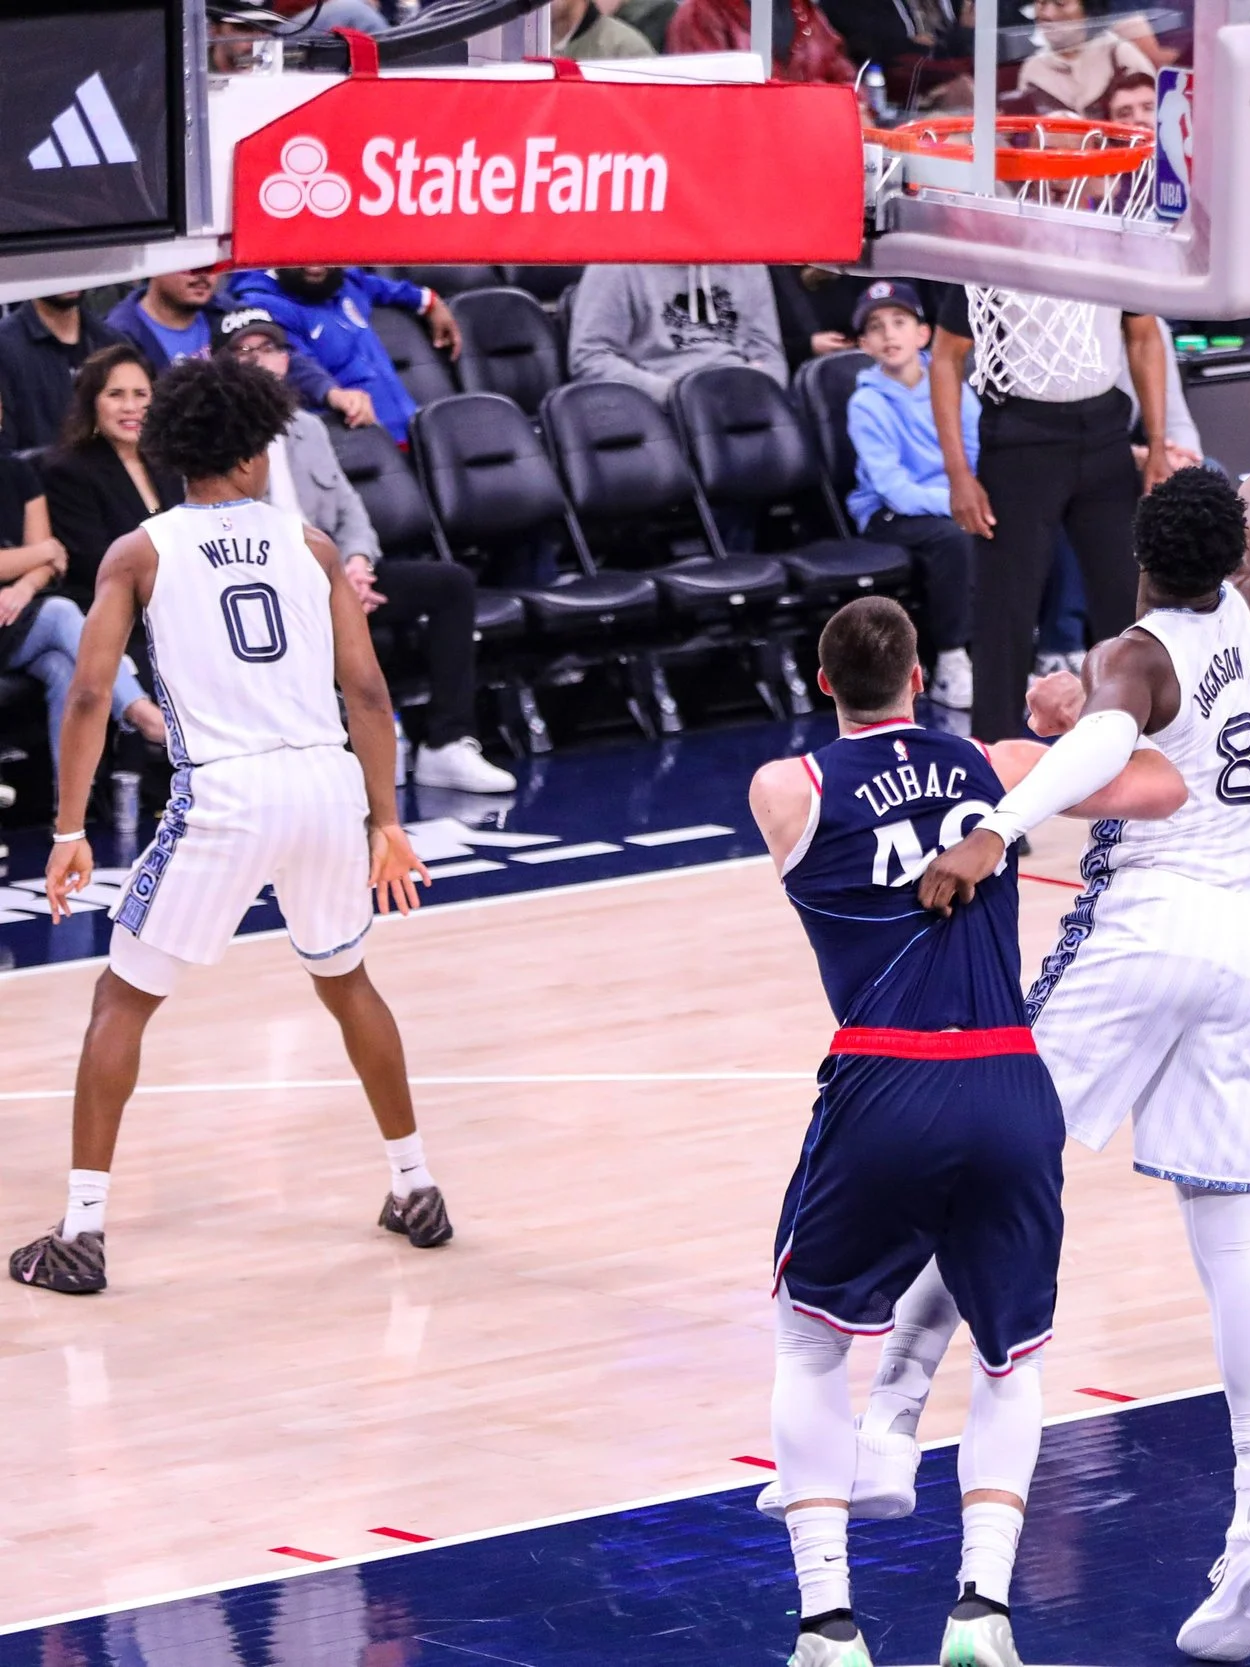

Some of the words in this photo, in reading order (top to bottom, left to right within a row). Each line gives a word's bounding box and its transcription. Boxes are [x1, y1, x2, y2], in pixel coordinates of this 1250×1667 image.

[1160, 182, 1182, 208] NBA
[198, 538, 270, 569] WELLS
[220, 582, 288, 663] 0
[1193, 646, 1245, 720] JACKSON
[854, 762, 967, 818] ZUBAC
